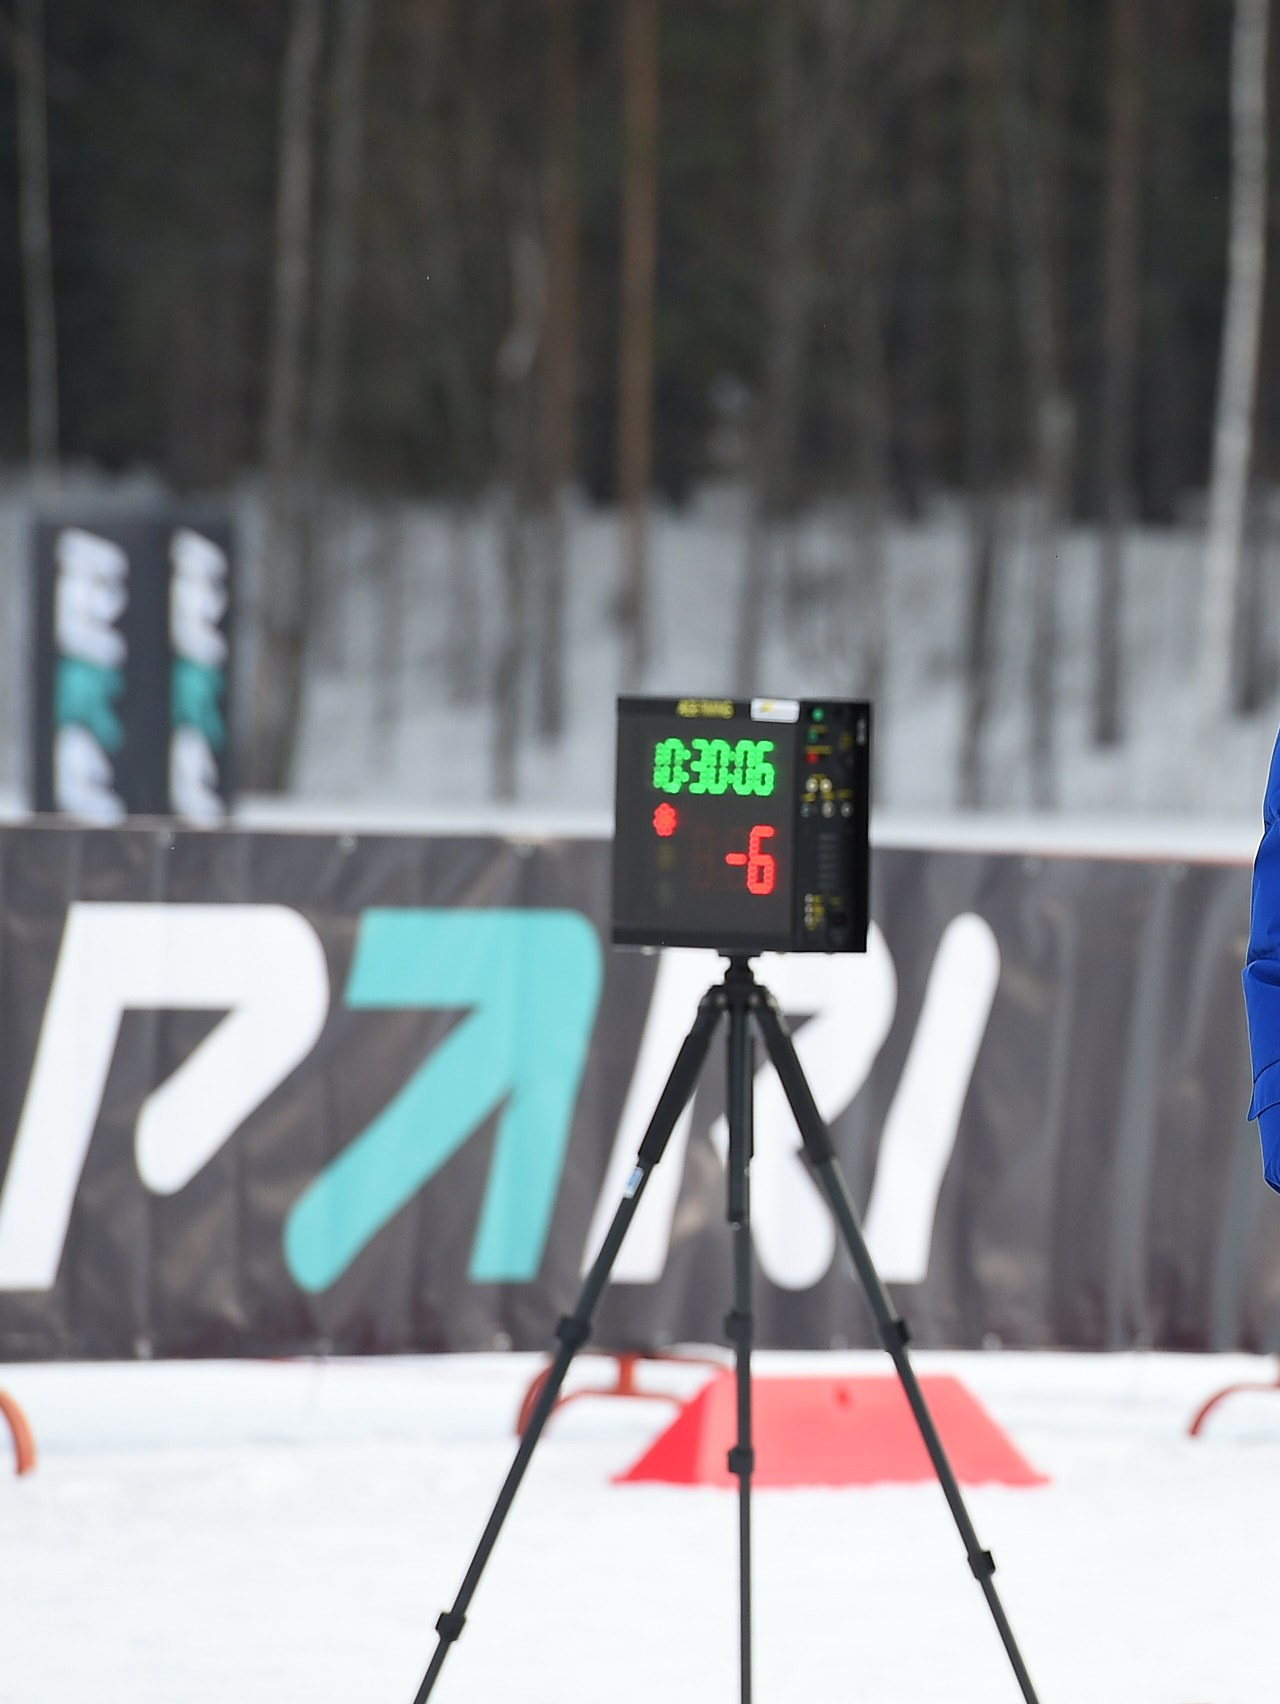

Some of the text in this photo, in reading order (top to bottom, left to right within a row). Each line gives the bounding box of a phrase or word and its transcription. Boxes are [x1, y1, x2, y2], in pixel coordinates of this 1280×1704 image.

[653, 737, 775, 797] 10:30:06
[725, 825, 776, 895] -6
[0, 900, 1001, 1293] PARI
